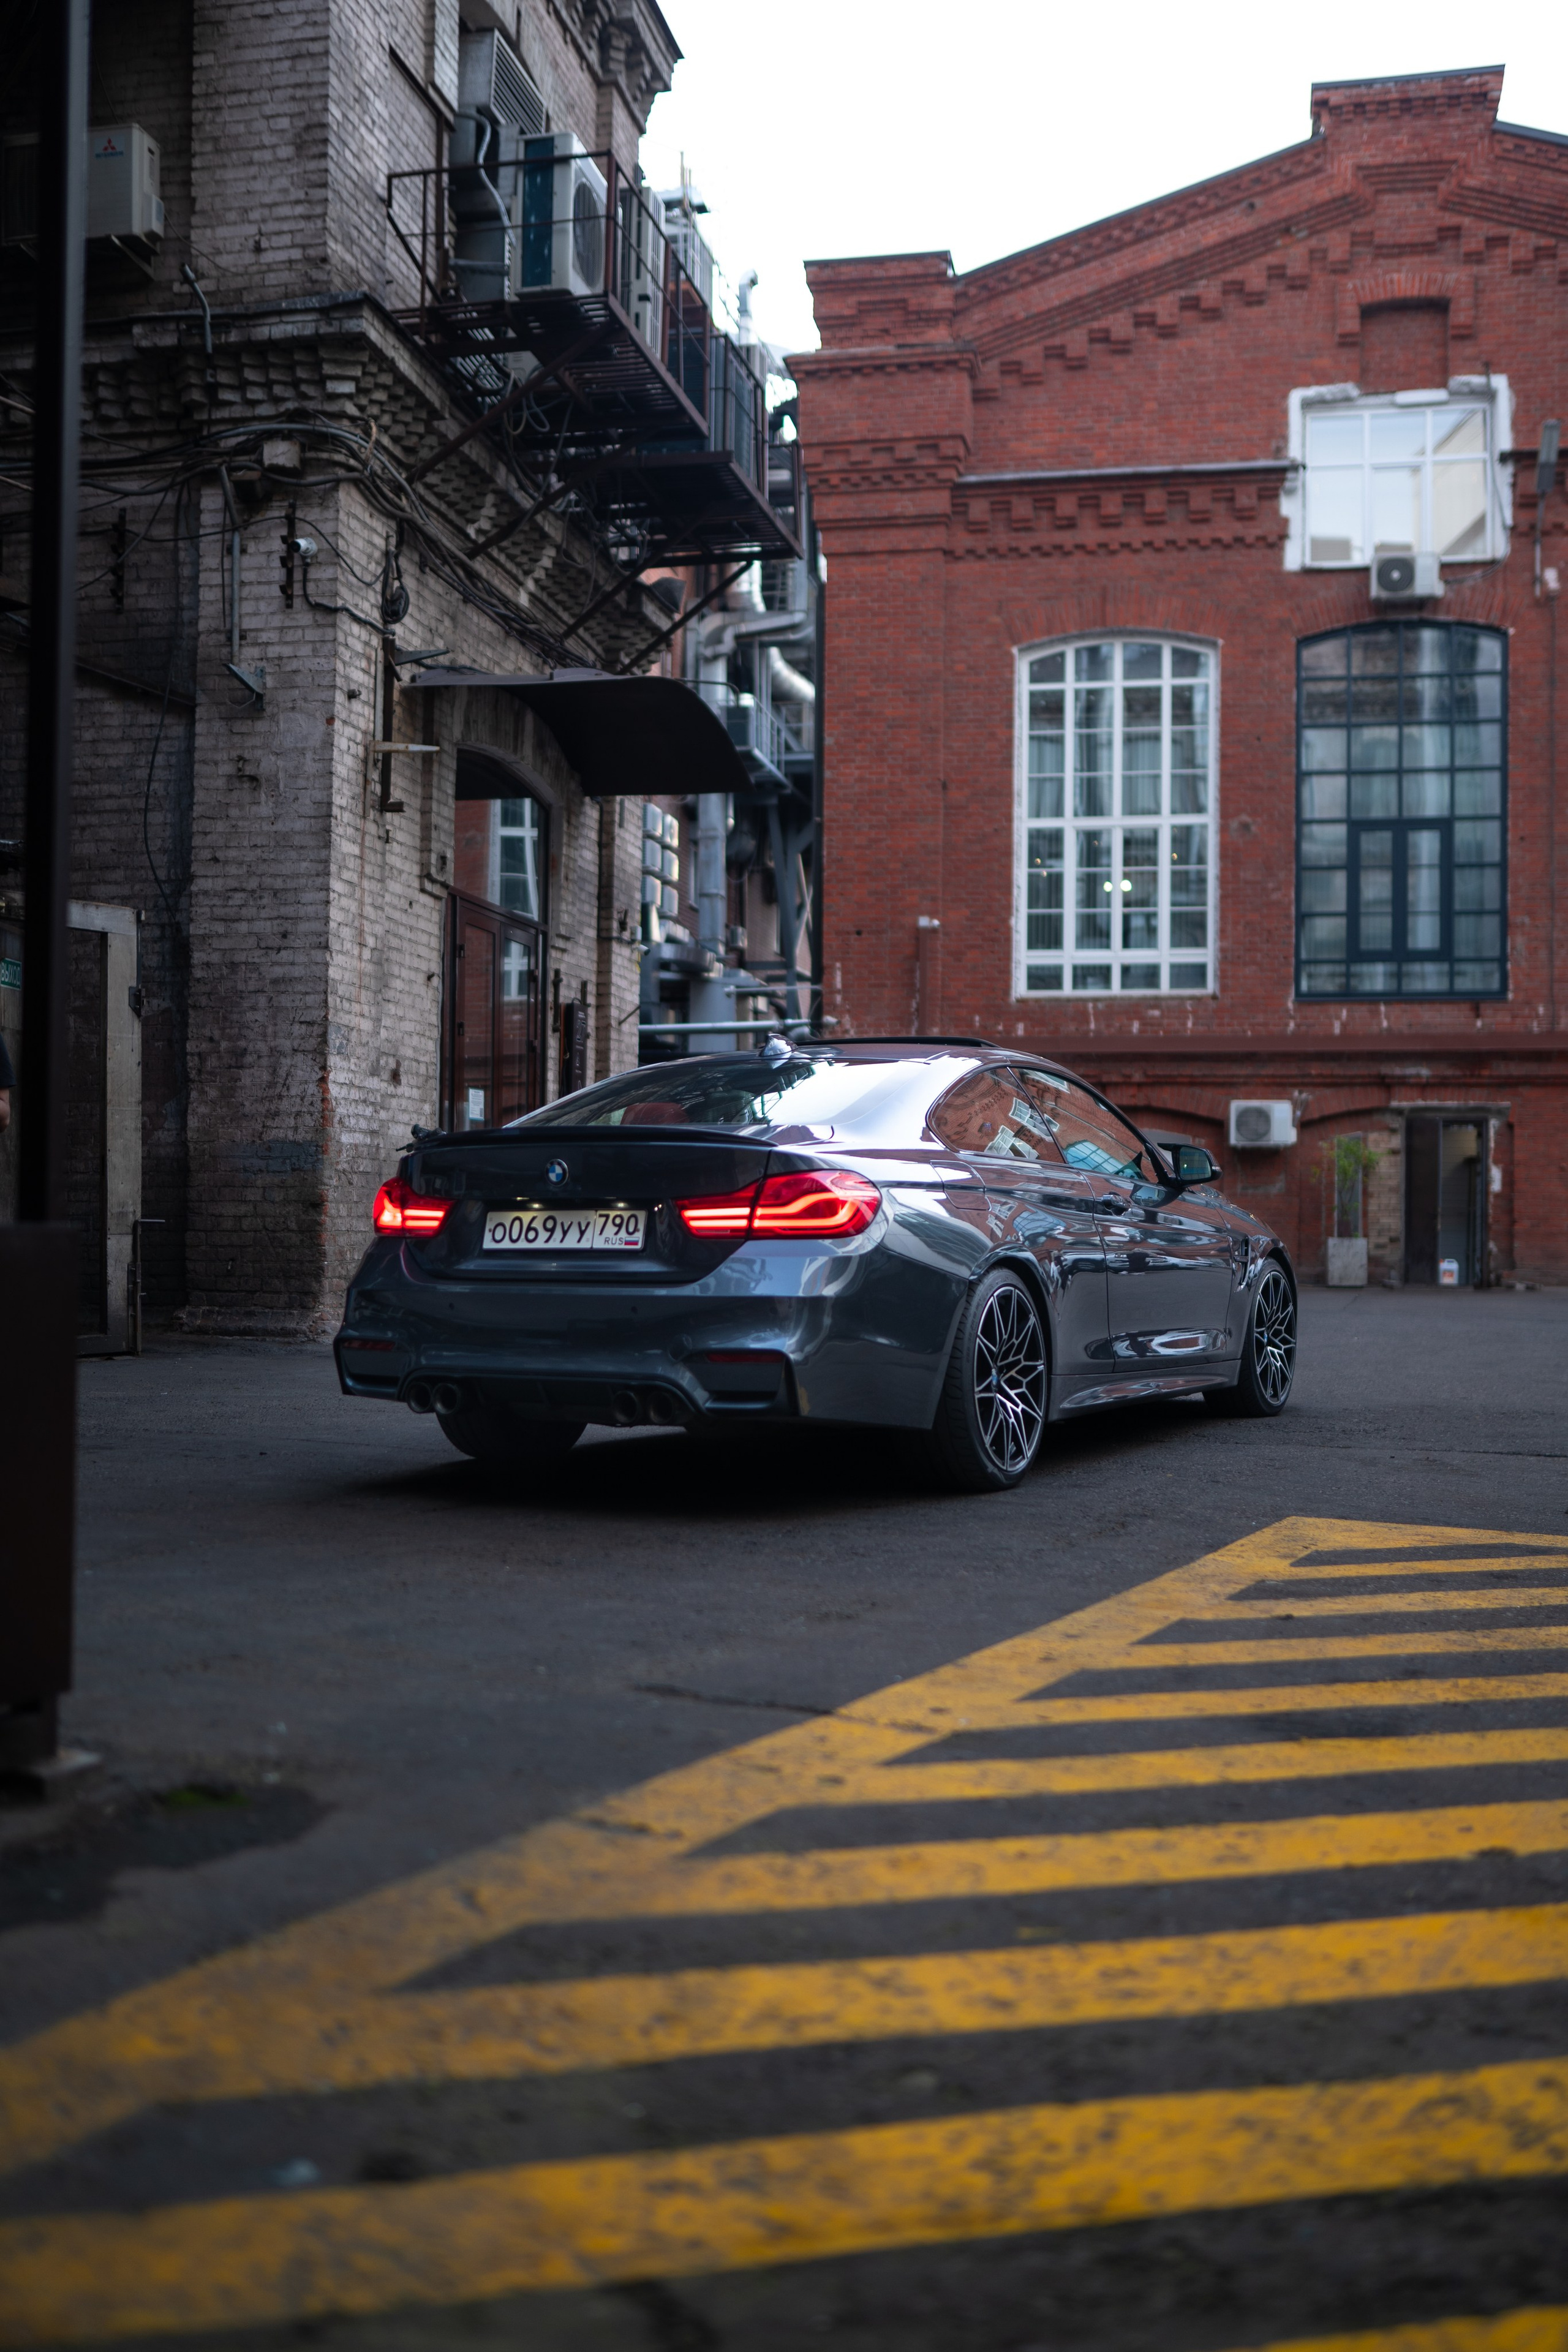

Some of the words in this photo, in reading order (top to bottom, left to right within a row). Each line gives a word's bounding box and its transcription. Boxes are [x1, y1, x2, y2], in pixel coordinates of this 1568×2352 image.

[1, 962, 20, 986] ВЫХОД
[598, 1213, 639, 1236] 790
[604, 1237, 624, 1245] RUS
